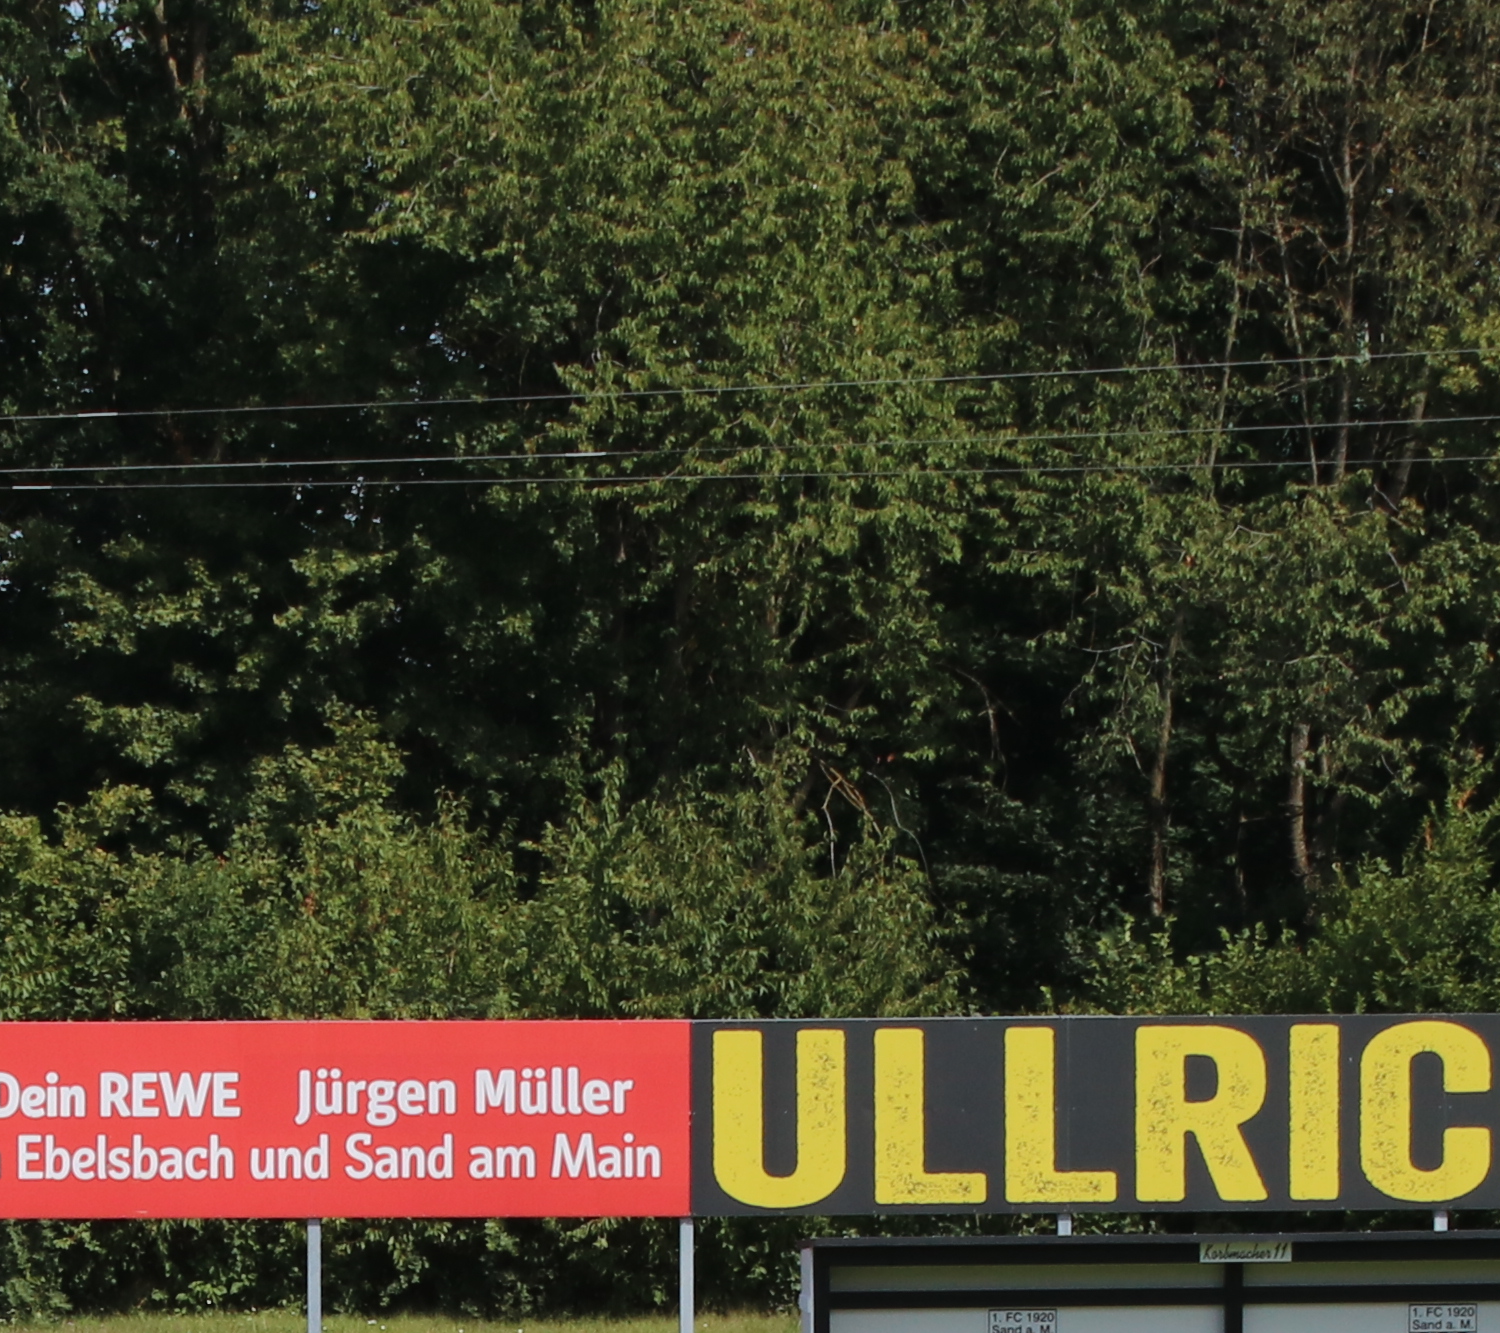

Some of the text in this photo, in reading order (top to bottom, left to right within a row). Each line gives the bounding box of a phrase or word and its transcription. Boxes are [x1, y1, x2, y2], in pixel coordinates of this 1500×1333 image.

[101, 1072, 241, 1117] REWE
[295, 1068, 457, 1126] Jürgen
[475, 1067, 633, 1115] Müller
[17, 1134, 234, 1181] Ebelsbach
[250, 1134, 329, 1180] und
[345, 1132, 453, 1179] Sand
[469, 1142, 536, 1178] am
[552, 1133, 662, 1178] Main
[1412, 1320, 1442, 1330] Sand
[1426, 1307, 1442, 1317] FC
[1448, 1307, 1474, 1317] 1920
